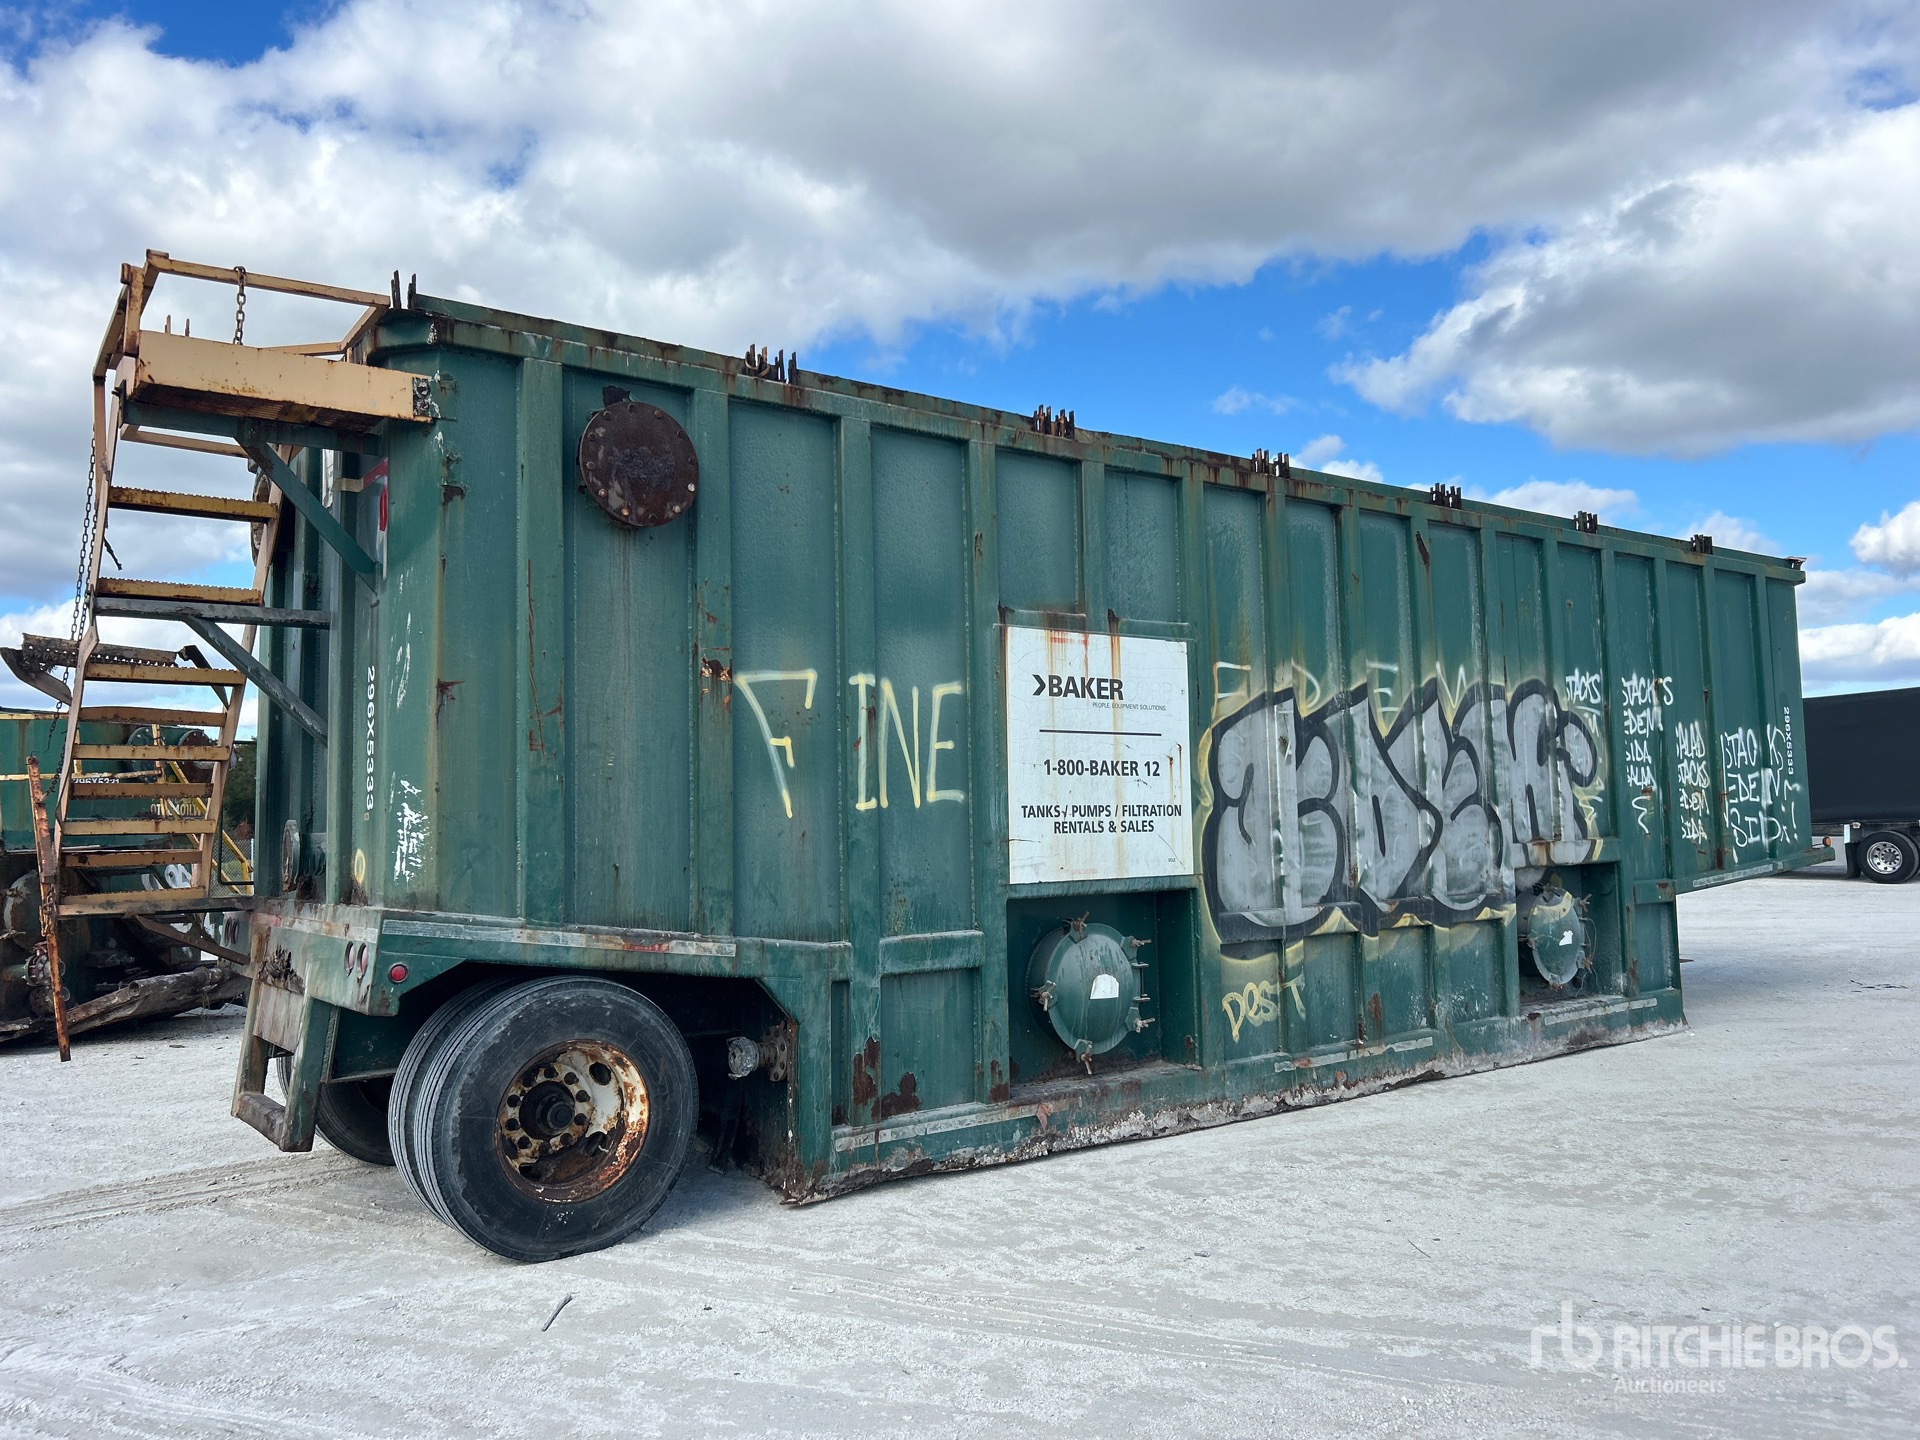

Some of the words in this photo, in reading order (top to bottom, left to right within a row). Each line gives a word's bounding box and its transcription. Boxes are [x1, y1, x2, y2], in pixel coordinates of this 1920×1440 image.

[1048, 674, 1124, 700] BAKER
[366, 665, 377, 811] 296X5333
[1783, 706, 1794, 775] 296X5333
[1043, 759, 1139, 776] 1-800-BAKER
[1144, 760, 1160, 777] 12
[1021, 804, 1061, 818] TANKS
[1071, 804, 1111, 818] PUMPS
[1122, 804, 1182, 817] FILTRATION
[1054, 821, 1104, 834] RENTALS
[1108, 822, 1117, 833] &
[1120, 820, 1155, 833] SALES
